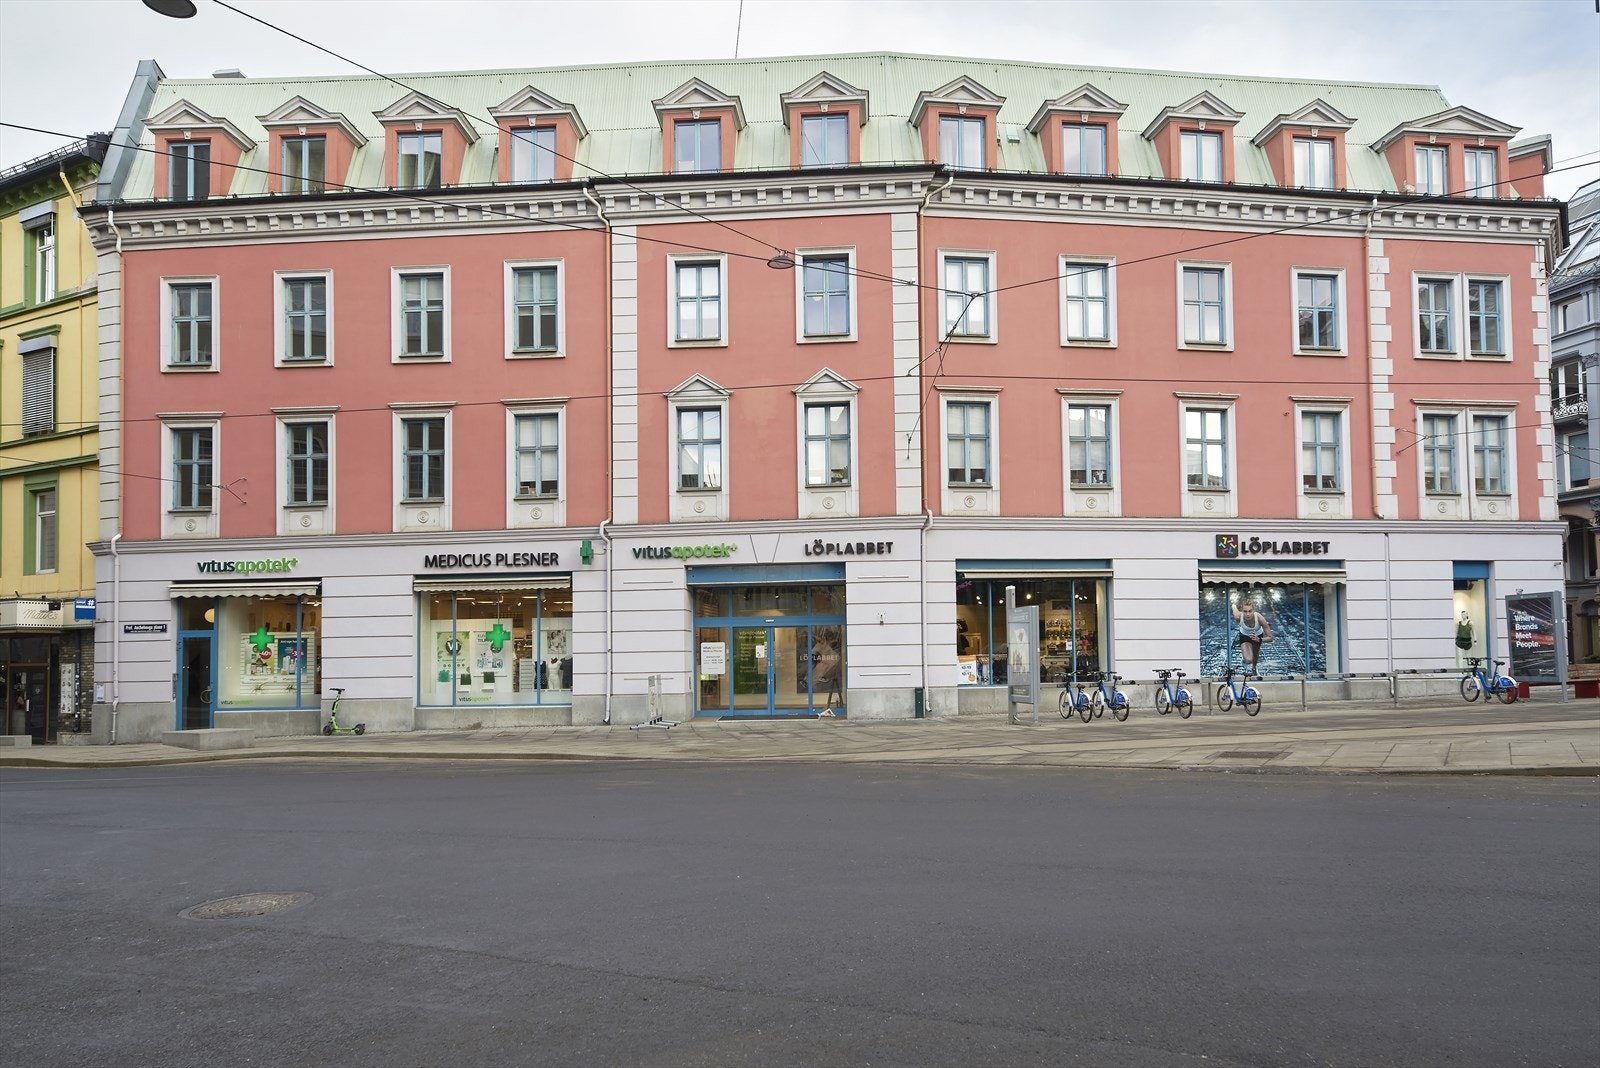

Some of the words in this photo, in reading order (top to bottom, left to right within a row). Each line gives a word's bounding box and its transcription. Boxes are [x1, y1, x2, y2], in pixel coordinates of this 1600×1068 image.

[804, 538, 893, 556] LÖPLABBET
[1241, 536, 1330, 555] LÖPLABBET
[424, 553, 491, 568] MEDICUS
[495, 552, 559, 567] PLESNER
[1514, 614, 1535, 622] Where
[1516, 641, 1541, 649] People.
[800, 653, 838, 661] LÖLABBET
